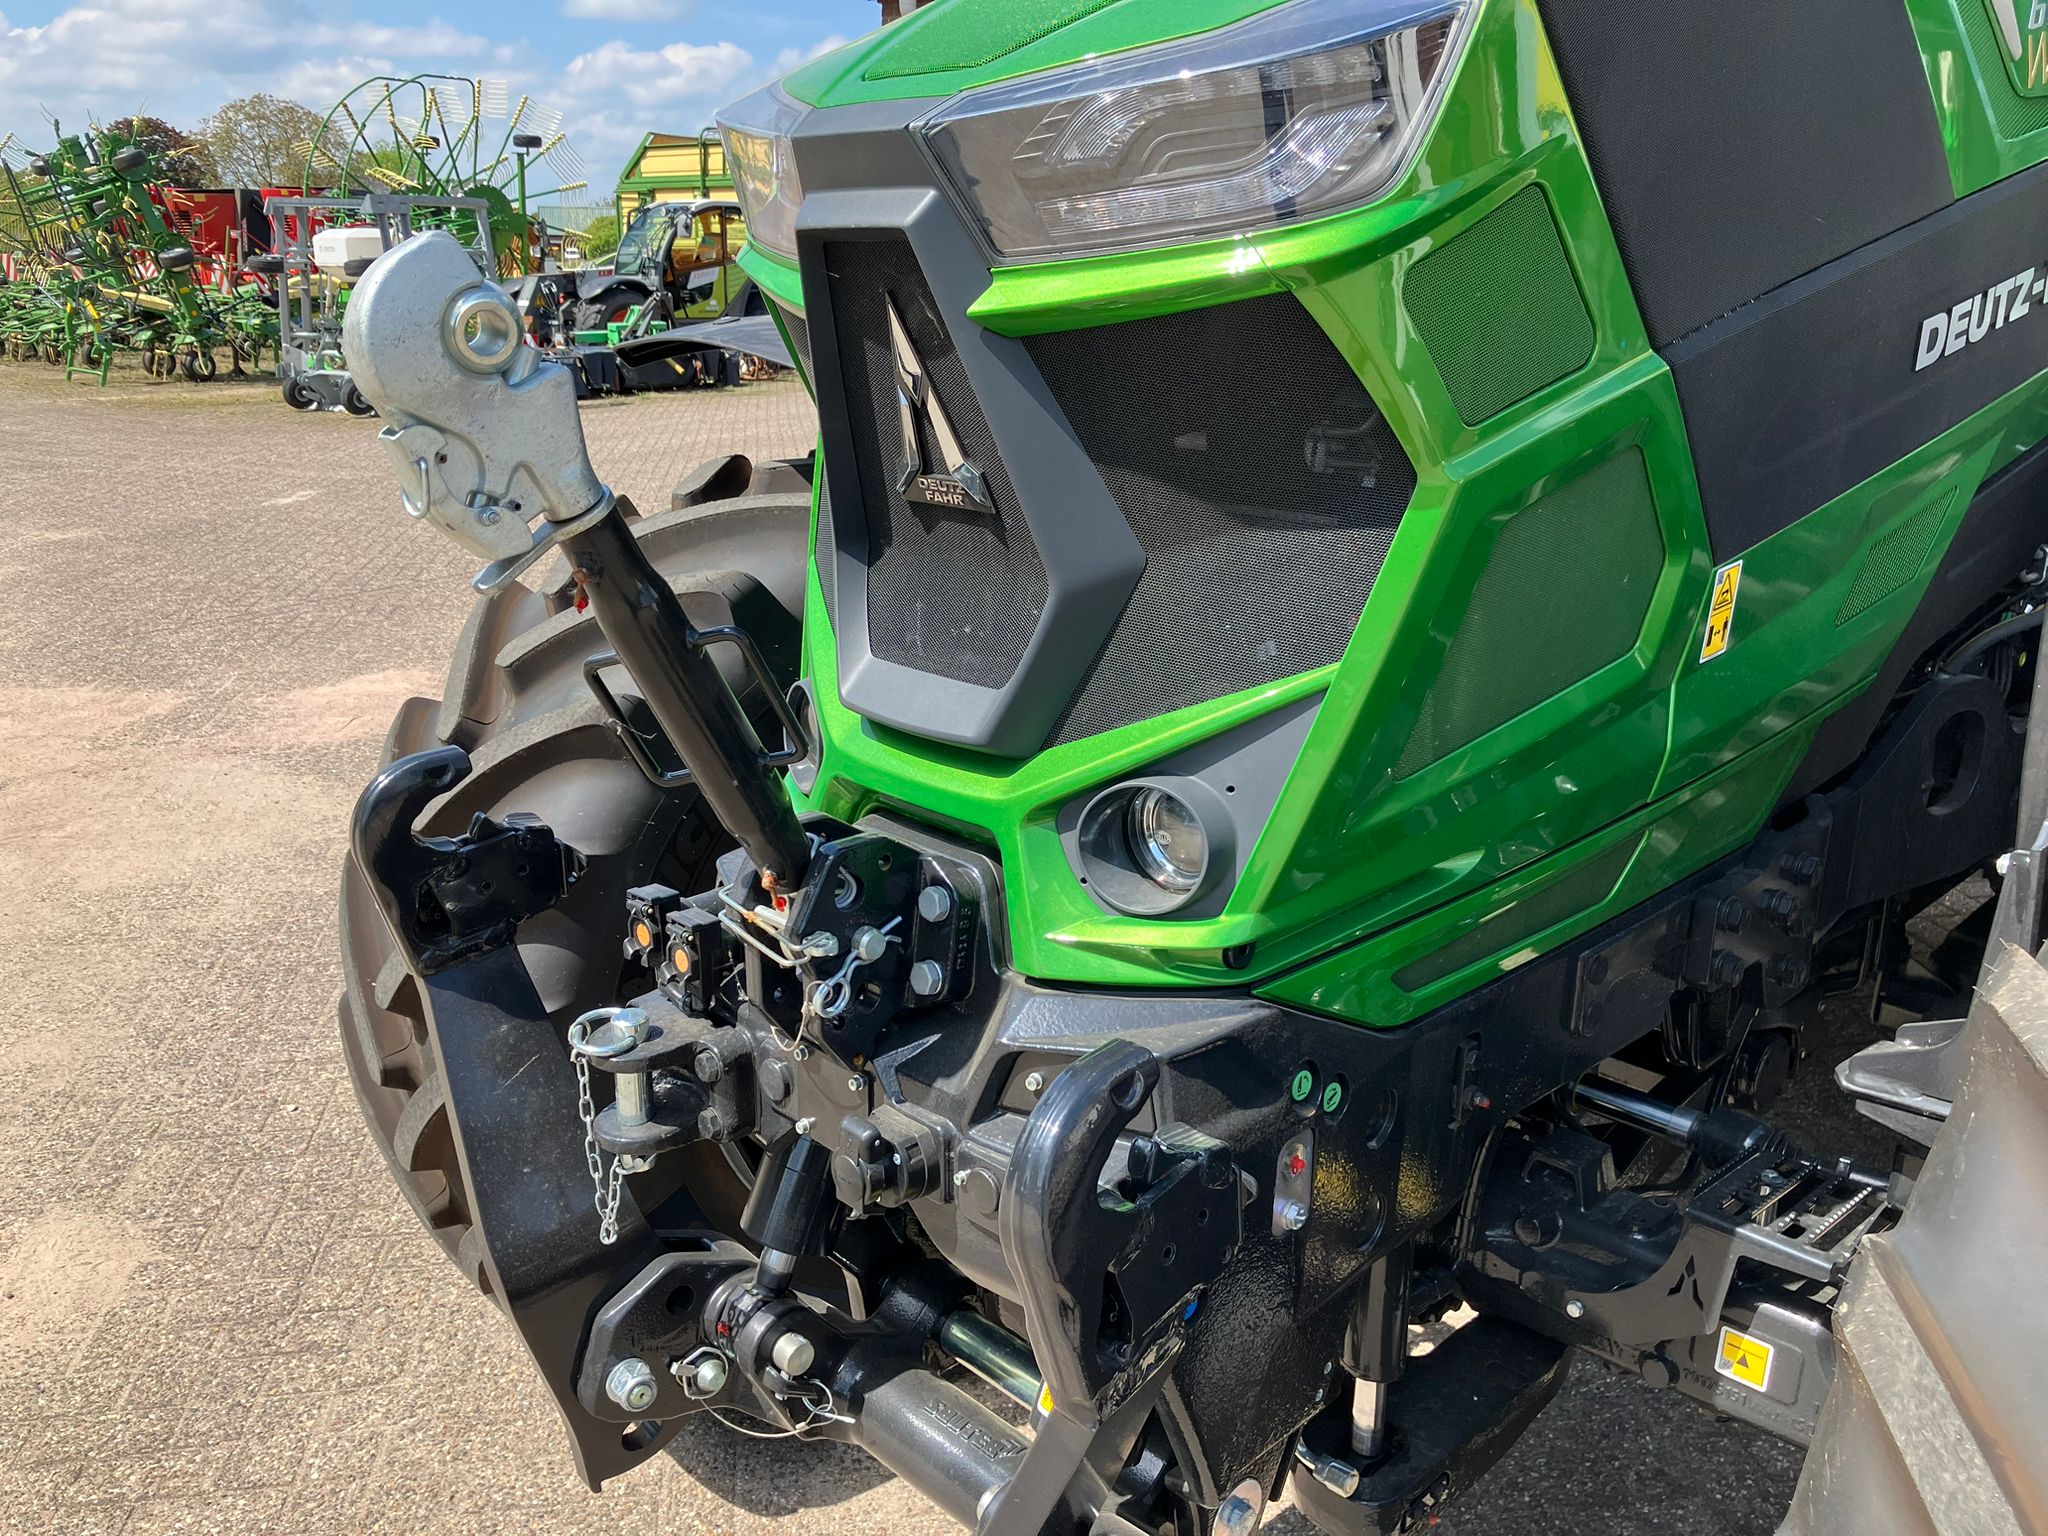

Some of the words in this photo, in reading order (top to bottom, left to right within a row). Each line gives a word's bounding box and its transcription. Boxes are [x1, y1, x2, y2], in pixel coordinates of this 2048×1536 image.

[1915, 266, 2048, 372] DEUTZ-
[917, 477, 966, 495] DEUTZ
[925, 490, 965, 506] FAHR
